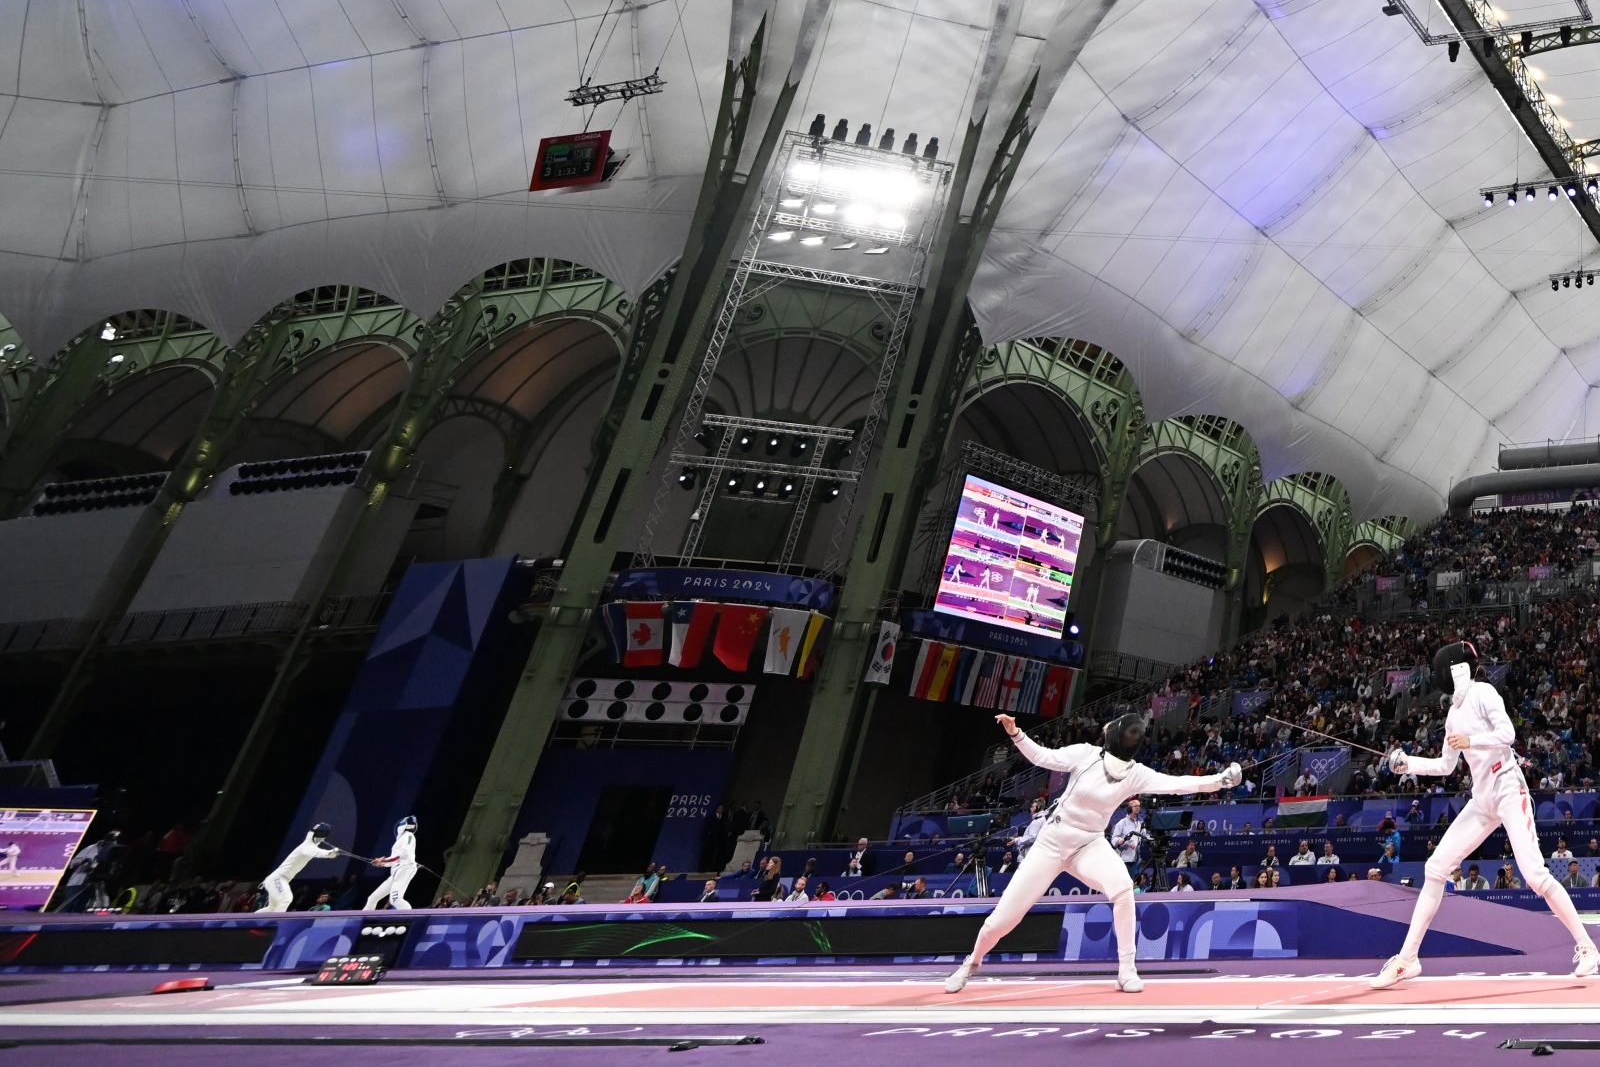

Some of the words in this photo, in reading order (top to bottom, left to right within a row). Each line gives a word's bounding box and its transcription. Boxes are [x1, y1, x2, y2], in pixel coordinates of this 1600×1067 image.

[544, 167, 552, 177] 3
[583, 162, 591, 172] 3
[733, 579, 771, 591] 2024
[1010, 636, 1028, 646] 2024
[670, 795, 711, 805] PARIS
[666, 807, 707, 818] 2024
[1190, 1027, 1488, 1040] 2024
